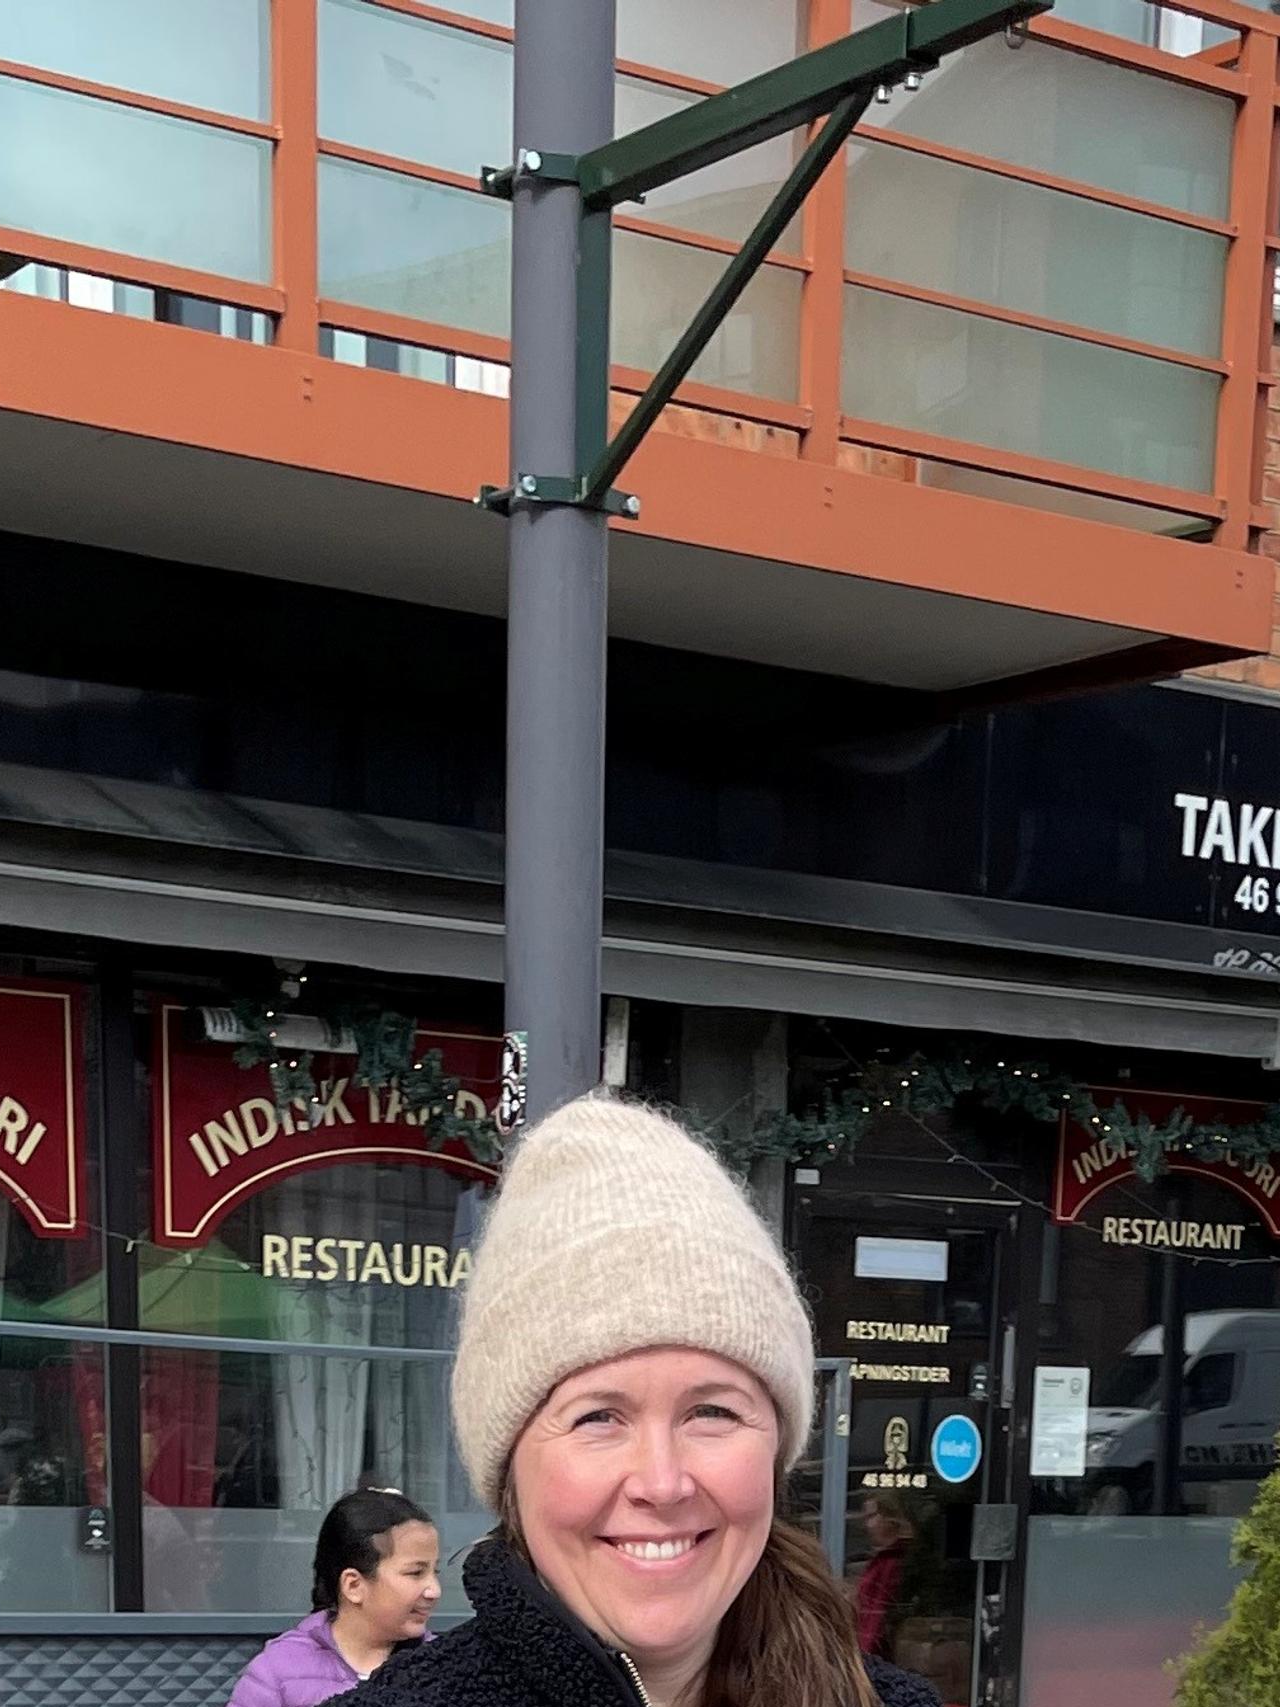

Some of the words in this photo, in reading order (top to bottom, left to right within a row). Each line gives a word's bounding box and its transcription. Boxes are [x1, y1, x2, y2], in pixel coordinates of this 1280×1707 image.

[1234, 876, 1269, 912] 46
[1103, 1217, 1245, 1250] RESTAURANT
[846, 1320, 950, 1344] RESTAURANT
